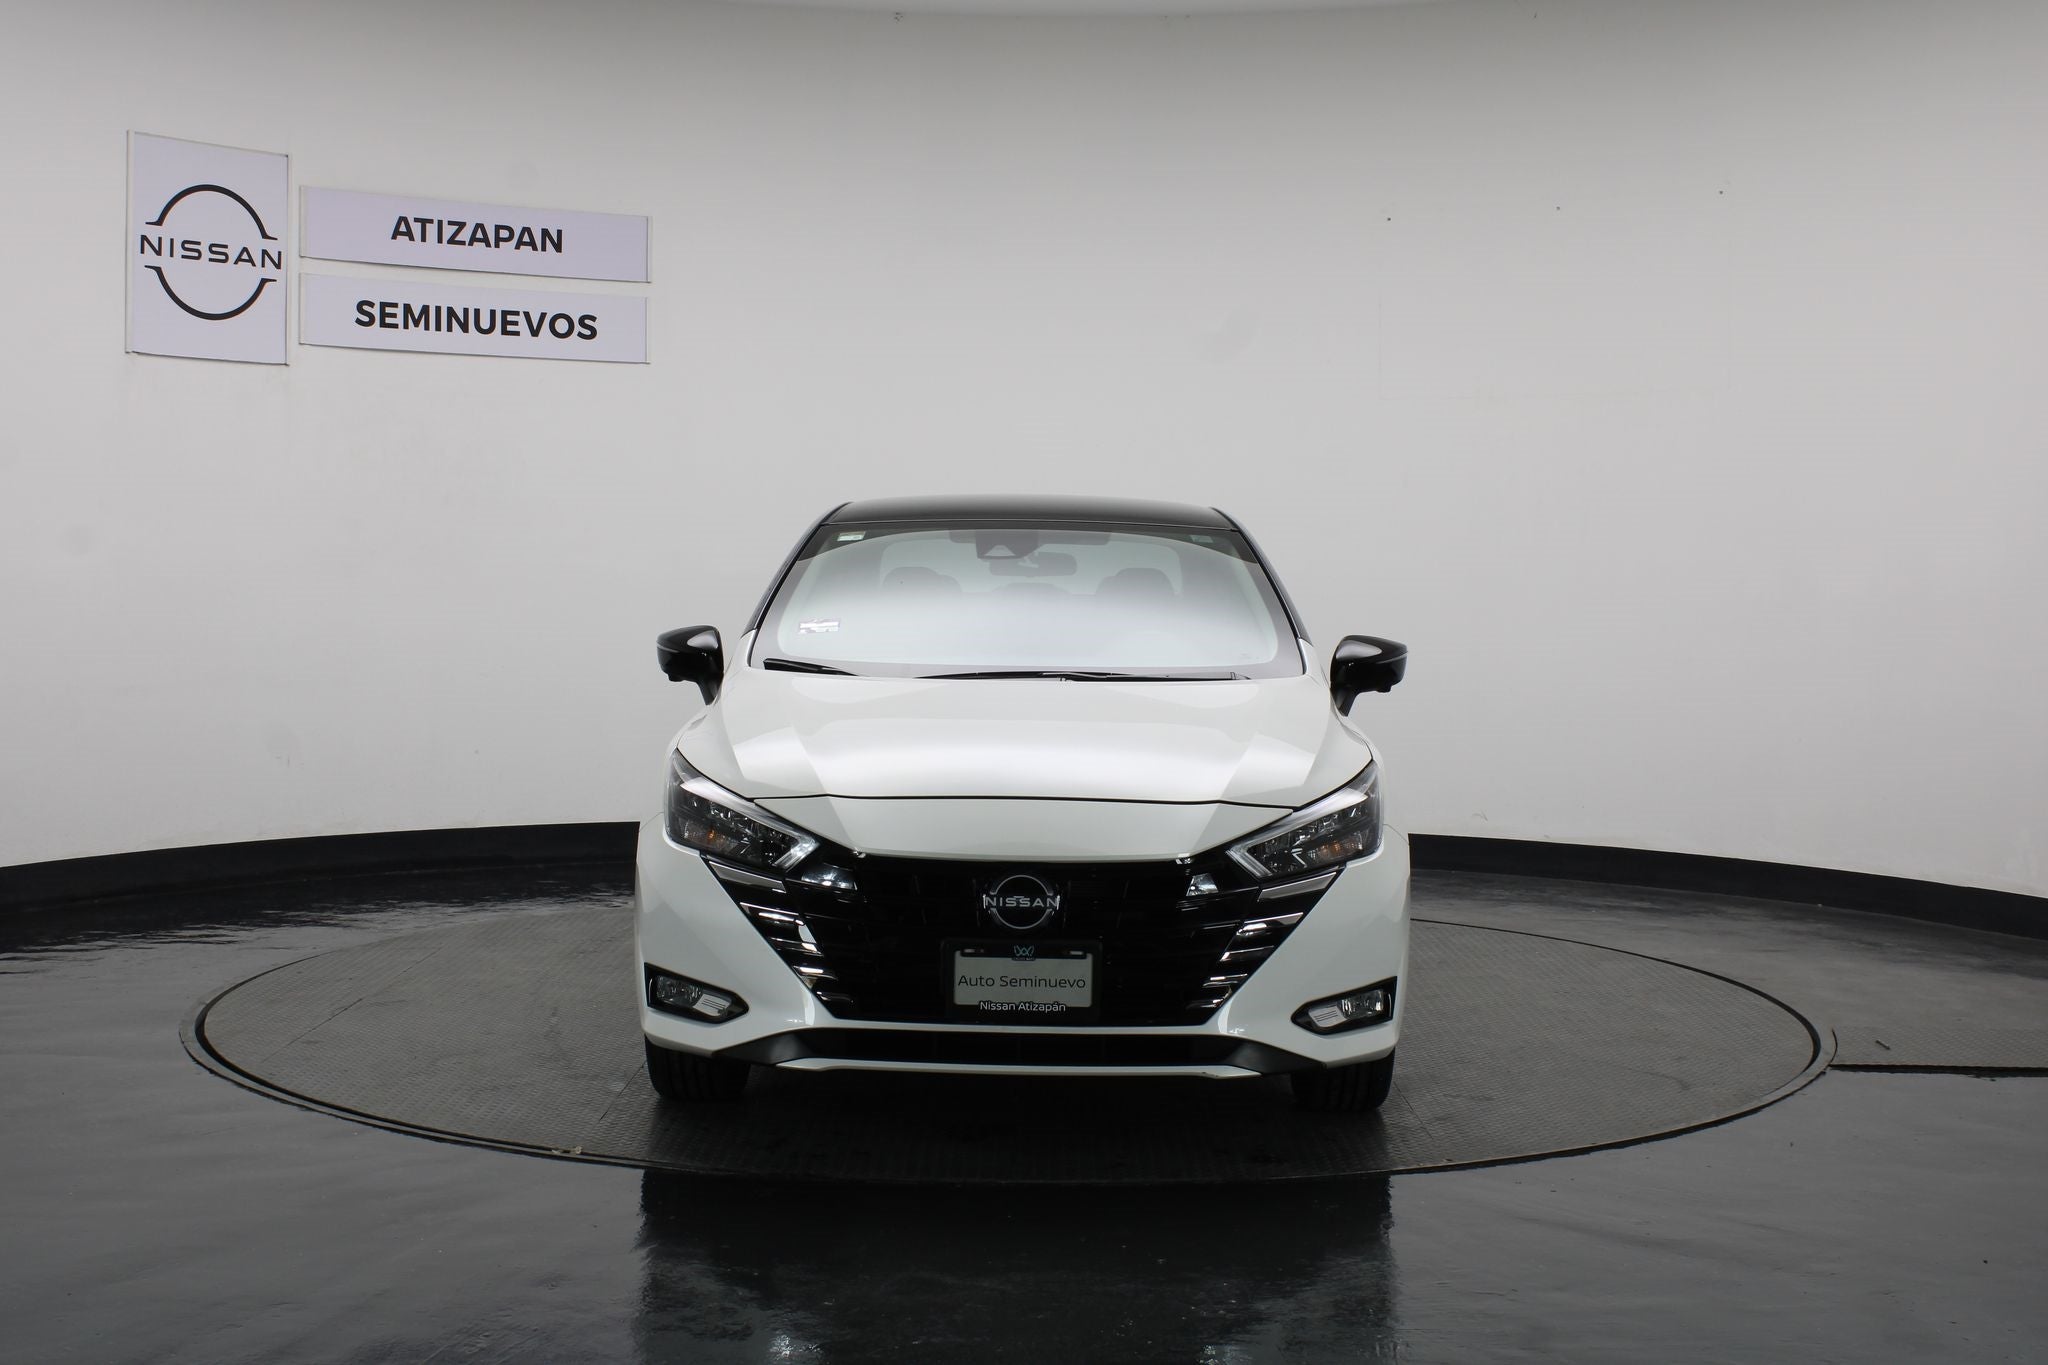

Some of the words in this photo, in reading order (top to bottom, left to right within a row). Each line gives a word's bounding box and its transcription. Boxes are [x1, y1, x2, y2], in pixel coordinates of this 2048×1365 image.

[391, 216, 564, 253] ATIZAPAN
[140, 234, 282, 270] NISSAN
[354, 300, 599, 340] SEMINUEVOS
[984, 896, 1059, 909] NISSAN
[958, 975, 995, 987] Auto
[999, 975, 1086, 989] Seminuevo
[980, 1001, 1016, 1011] Nissan
[1018, 1001, 1066, 1013] Atizapán
